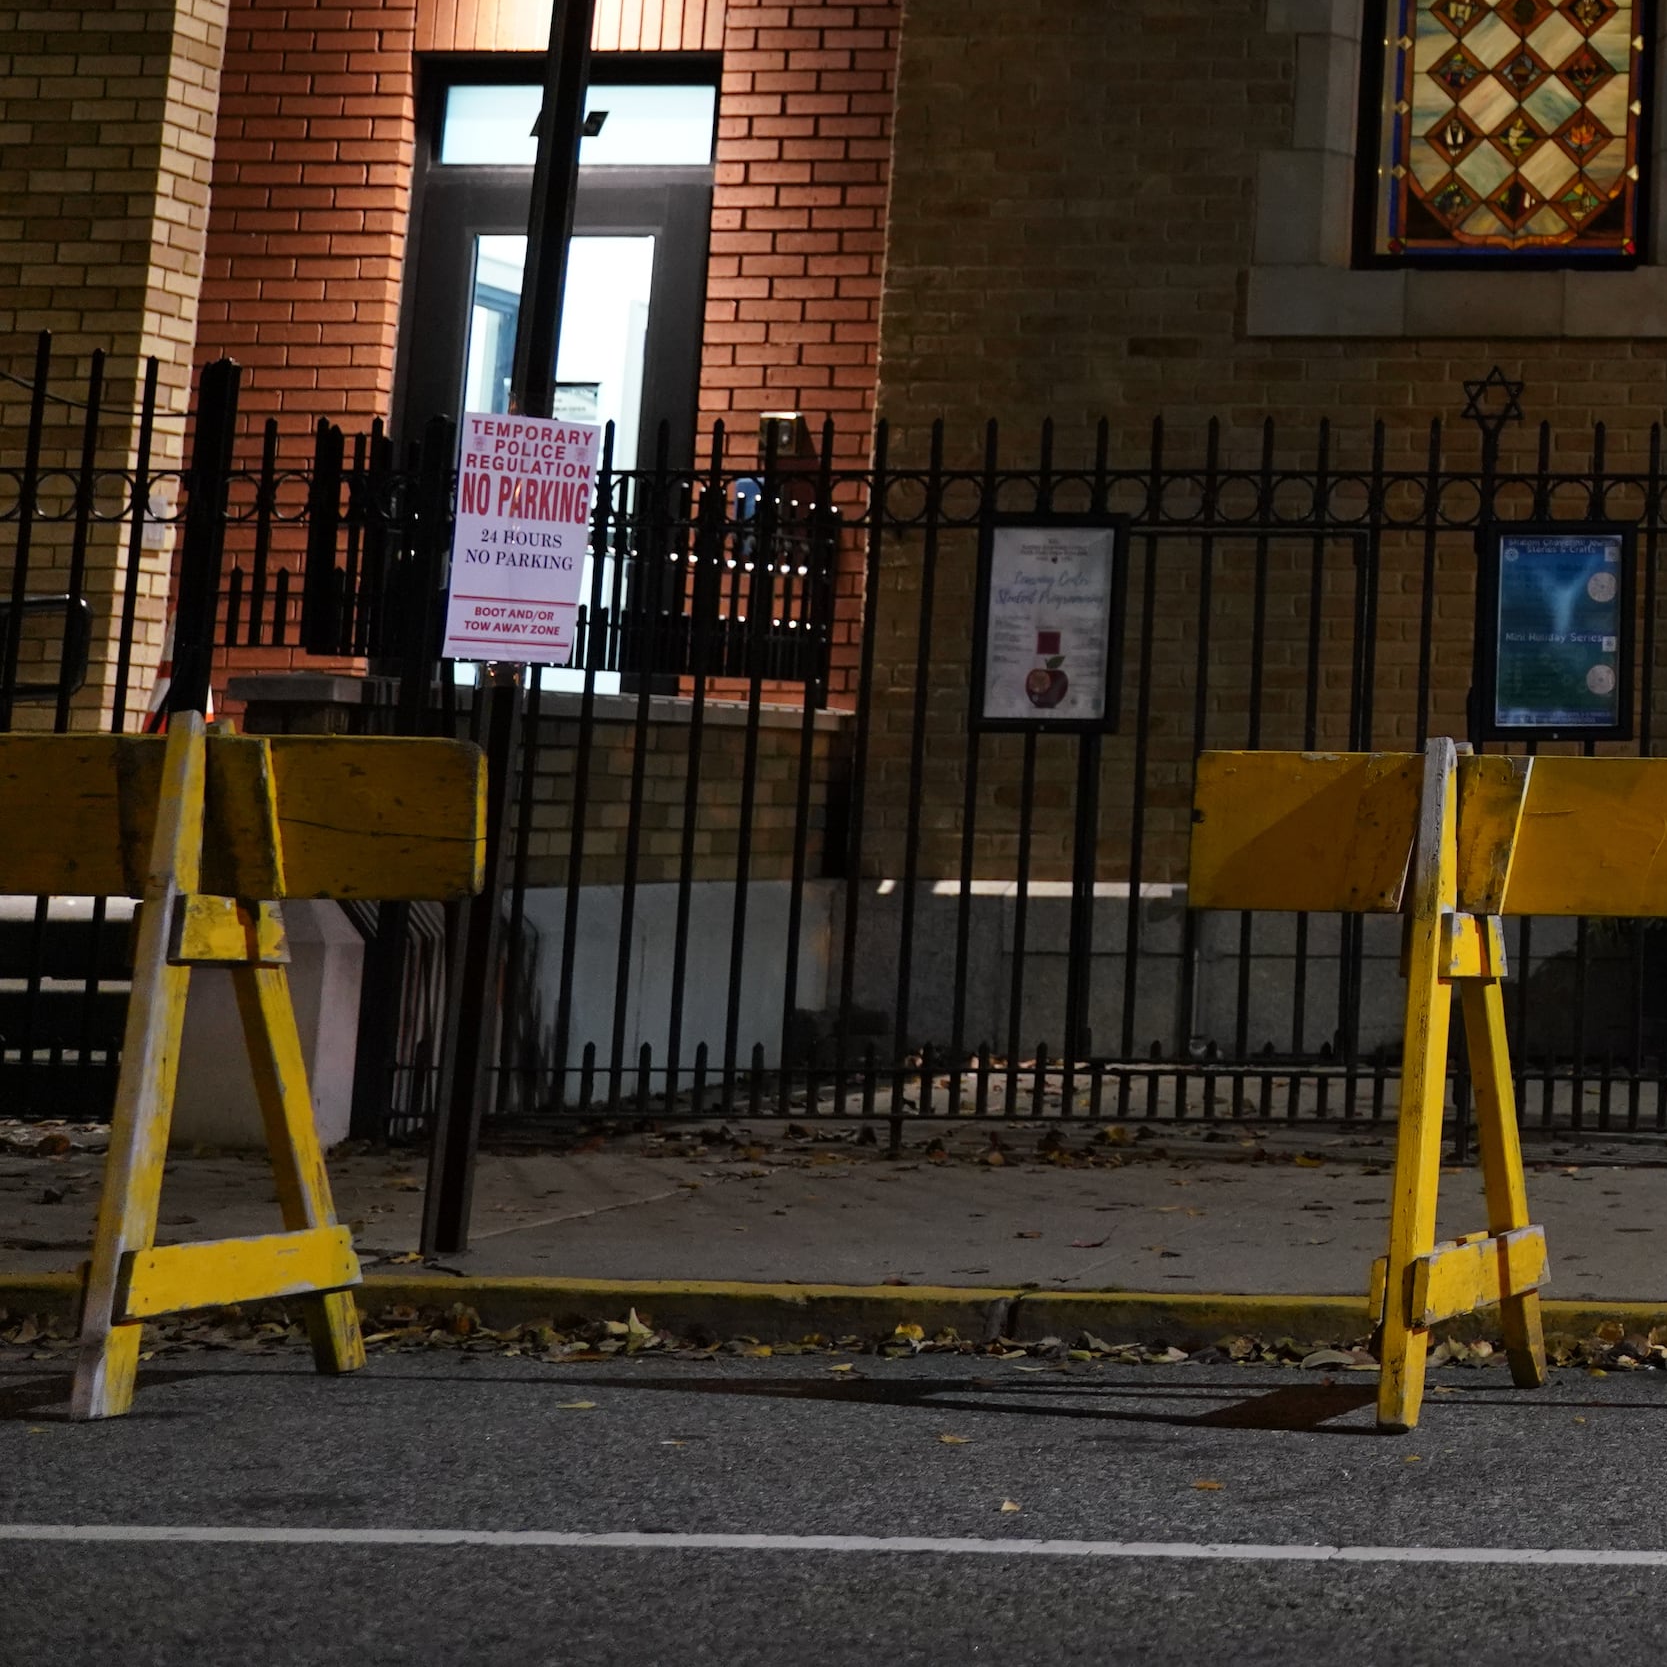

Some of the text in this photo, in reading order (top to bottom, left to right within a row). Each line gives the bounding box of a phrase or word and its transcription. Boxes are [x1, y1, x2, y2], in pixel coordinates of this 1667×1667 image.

[471, 419, 594, 446] TEMPORARY
[494, 439, 567, 460] POLICE
[466, 453, 591, 479] REGULATION
[461, 472, 589, 524] NO PARKING
[481, 529, 562, 549] 24 HOURS
[465, 549, 574, 571] NO PARKING
[474, 606, 554, 622] BOOT AND/OR
[464, 620, 560, 636] TOW AWAY ZONE
[1505, 632, 1602, 644] Mini Holiday Series
